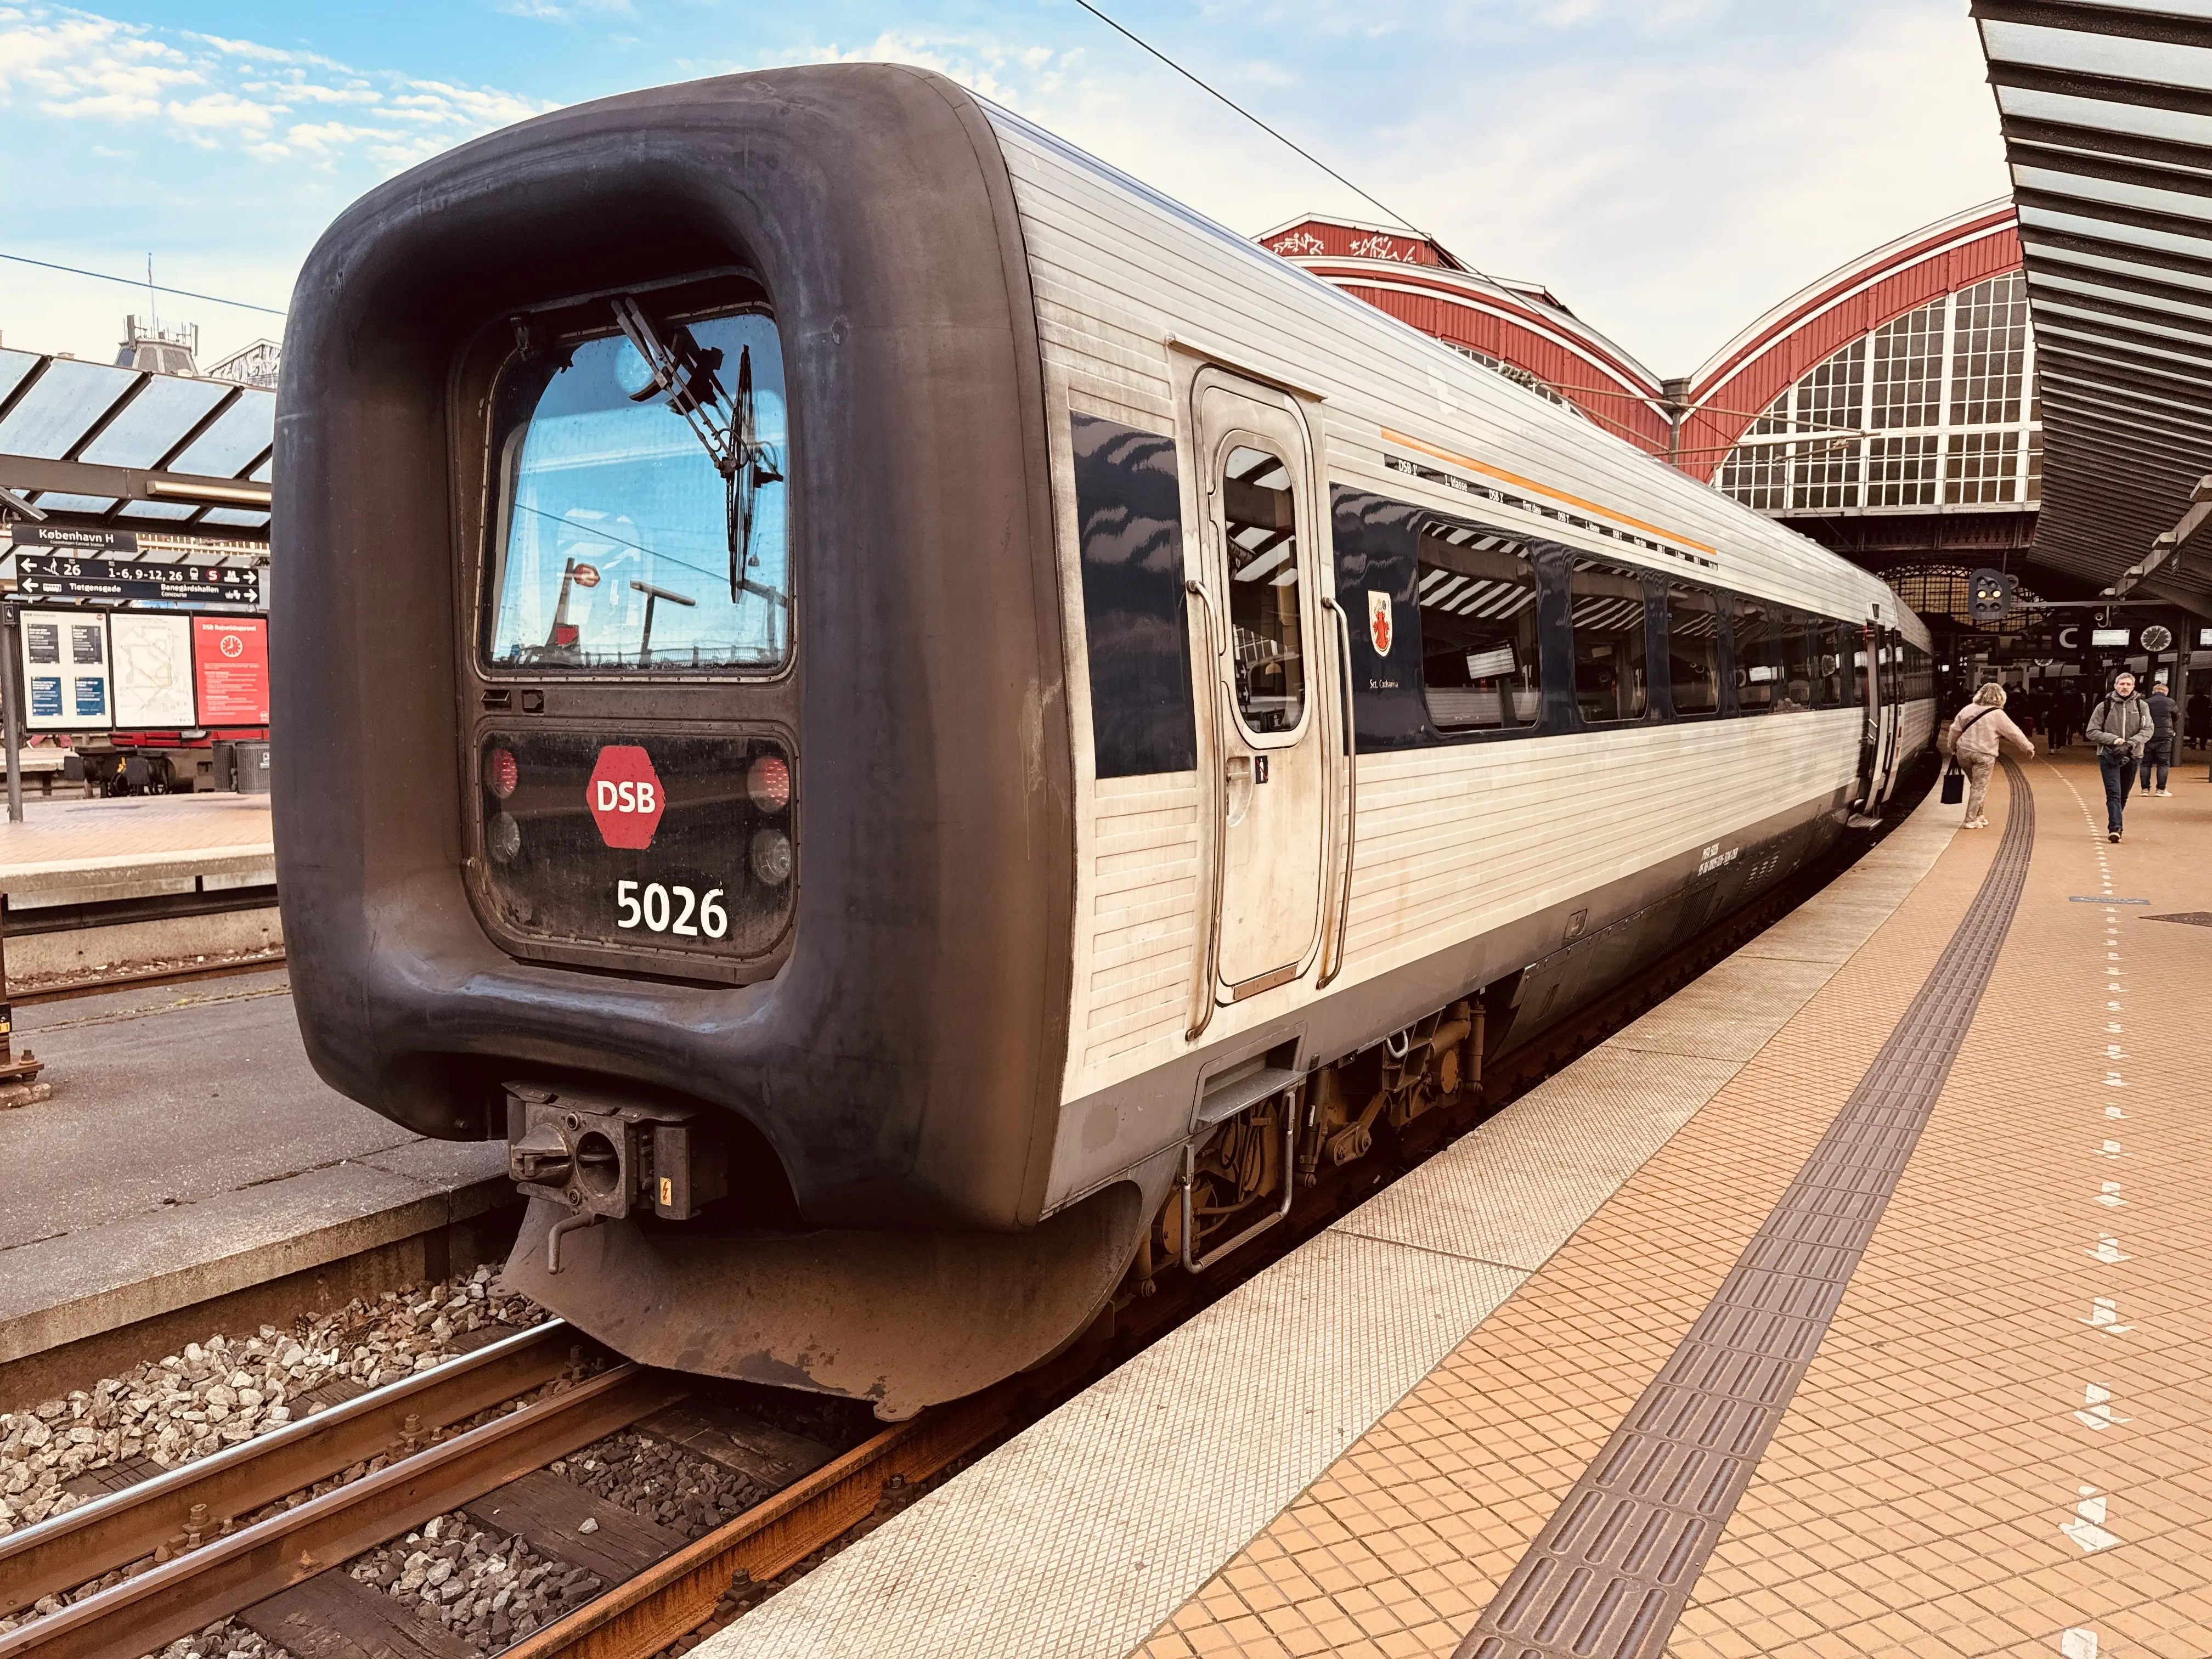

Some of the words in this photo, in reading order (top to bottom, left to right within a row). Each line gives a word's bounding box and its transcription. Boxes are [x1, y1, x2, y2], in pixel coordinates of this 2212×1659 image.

[1398, 459, 1412, 474] DSB
[1444, 475, 1450, 486] 1.
[1451, 476, 1468, 492] klasse
[1488, 489, 1498, 501] DSB
[1522, 500, 1532, 512] First
[1532, 503, 1542, 515] class
[1558, 511, 1566, 522] DSB
[39, 529, 103, 543] København
[105, 533, 114, 544] H
[64, 564, 81, 576] 26
[109, 568, 132, 580] 1-6,
[136, 569, 166, 582] 9-12,
[168, 571, 183, 582] 26
[69, 583, 121, 593] Tietgensgade
[2059, 627, 2078, 648] C
[597, 781, 656, 814] DSB
[617, 880, 728, 939] 5026
